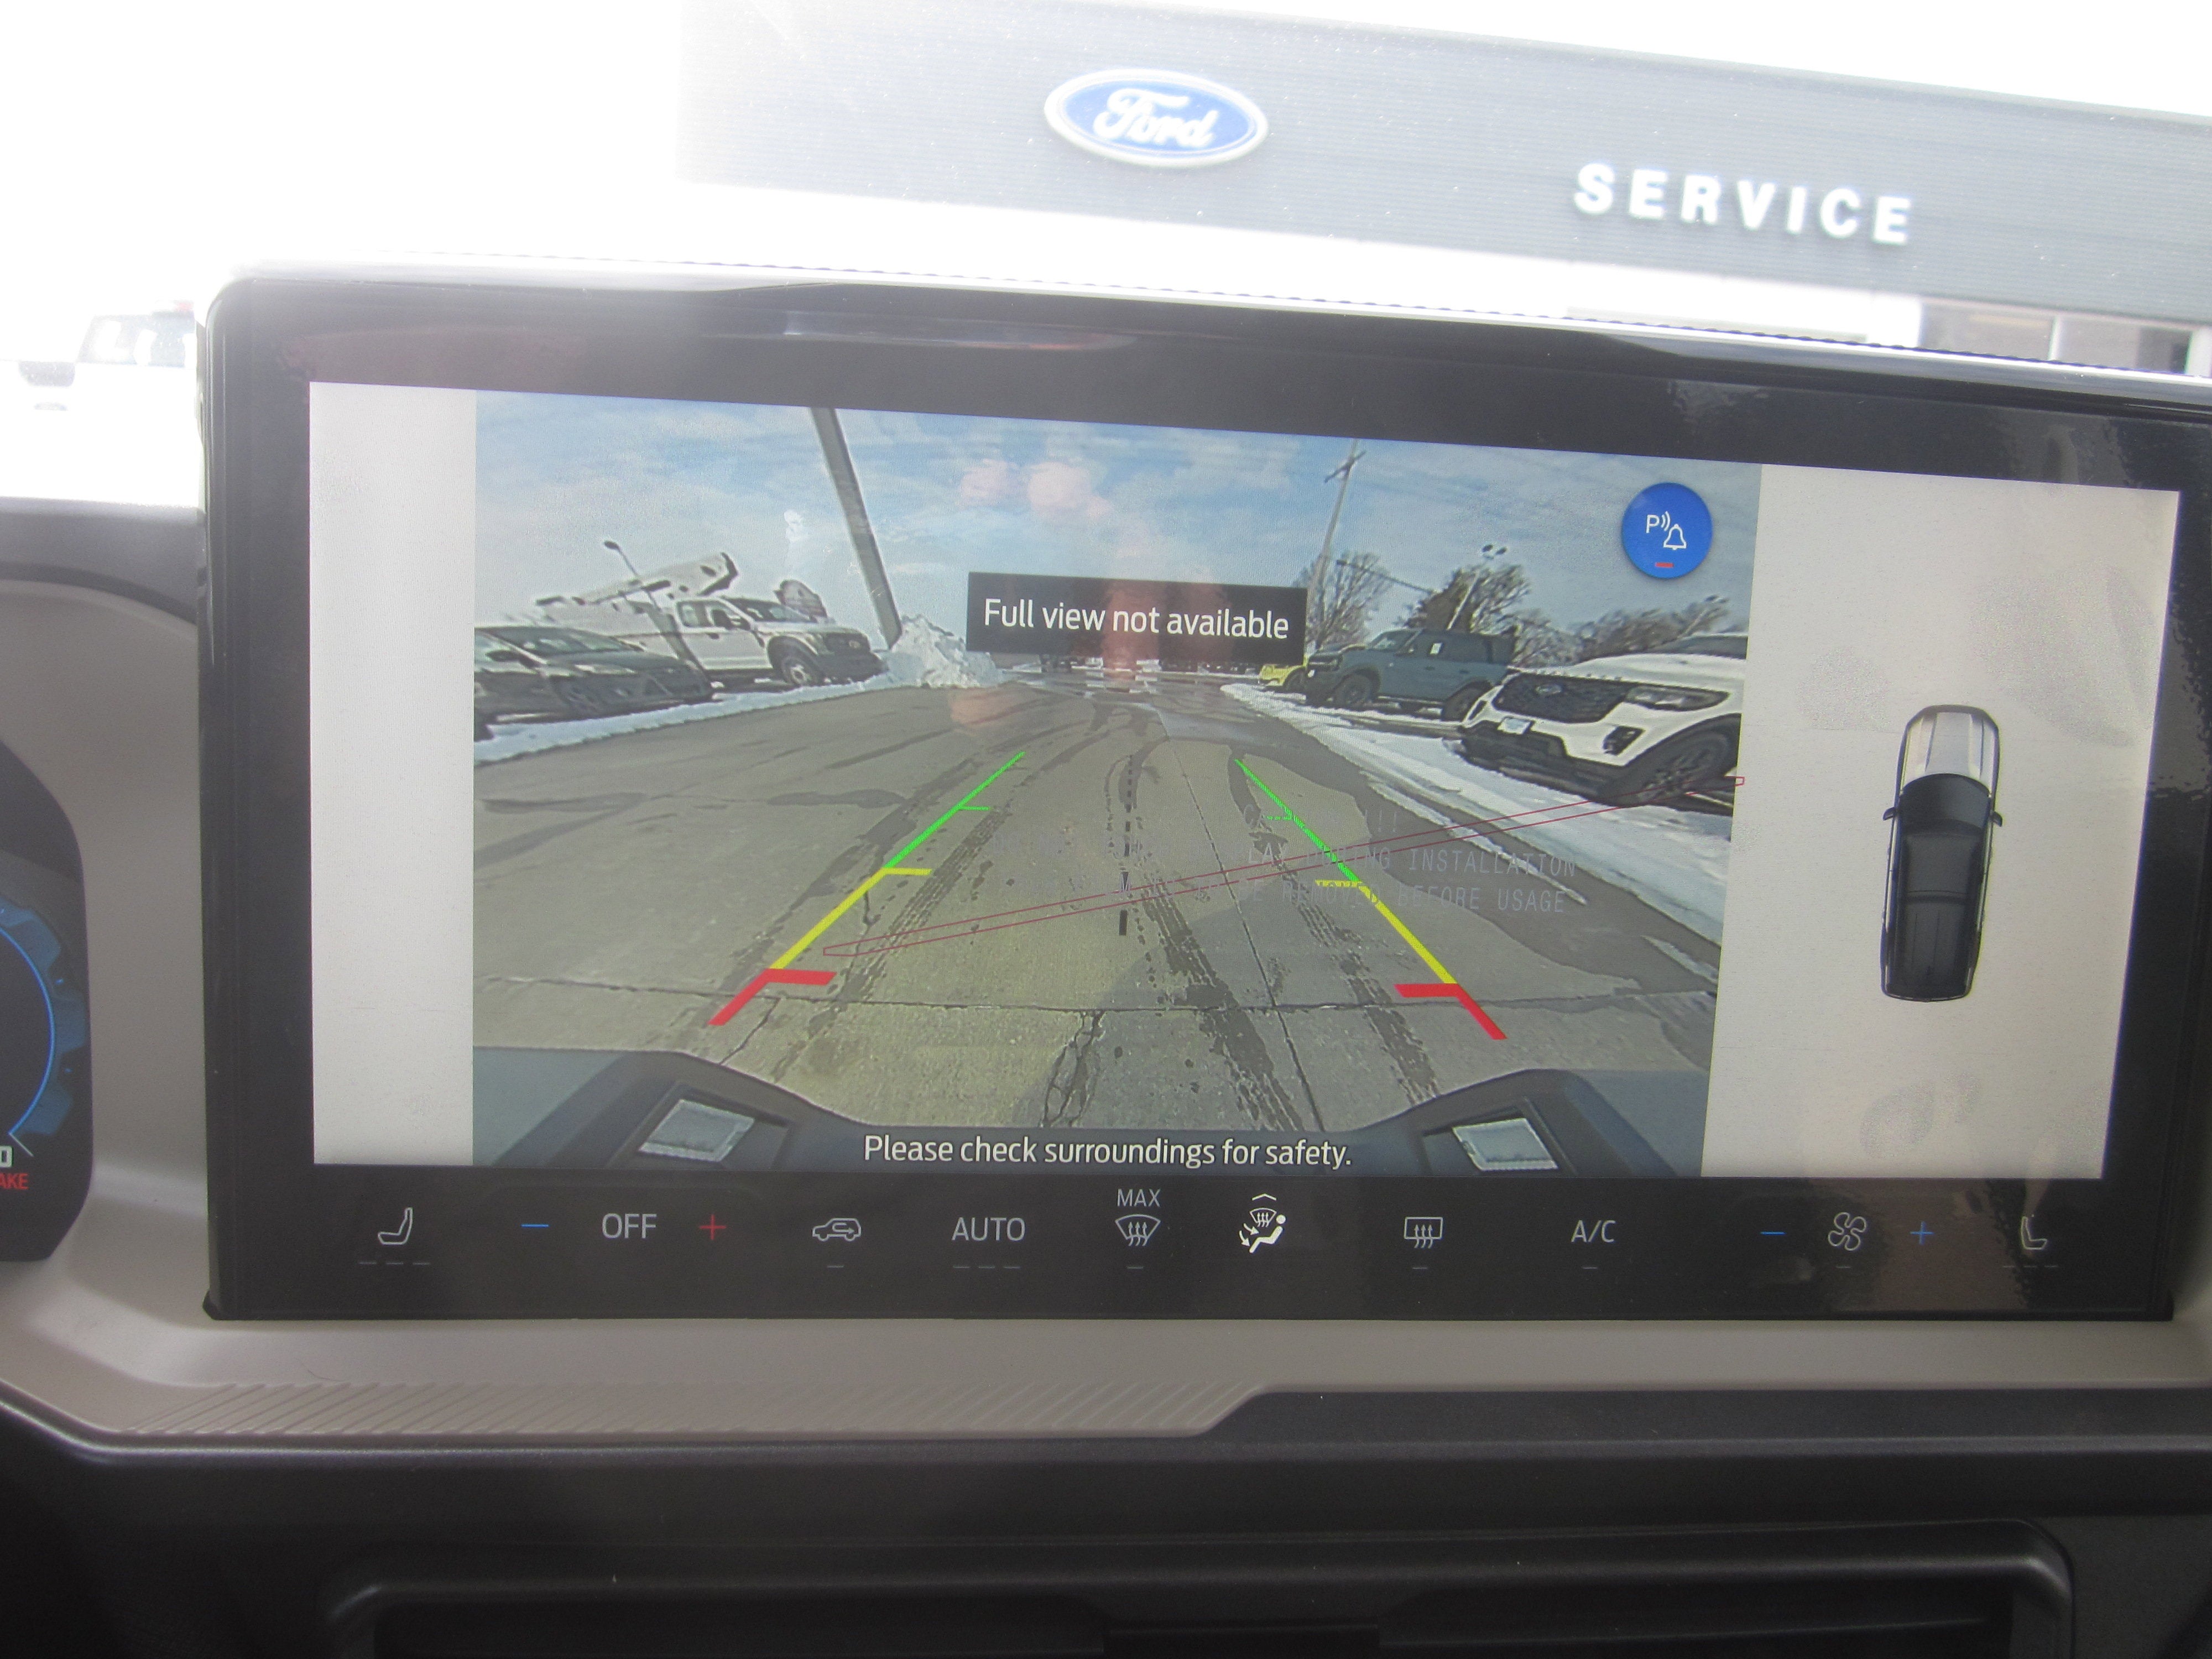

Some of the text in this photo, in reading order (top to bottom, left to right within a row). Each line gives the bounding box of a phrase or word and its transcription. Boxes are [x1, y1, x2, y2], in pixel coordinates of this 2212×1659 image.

[1093, 87, 1219, 148] Ford
[1573, 160, 1912, 244] SERVICE
[984, 598, 1289, 639] Full view not available
[1408, 848, 1576, 878] INSTALLATION
[1498, 888, 1566, 913] USAGE
[864, 1134, 1353, 1170] Please check surroundings for safety.
[1117, 1188, 1161, 1207] MAX
[602, 1213, 658, 1239] OFF
[951, 1217, 1026, 1241] AUTO
[1571, 1220, 1616, 1243] A/C
